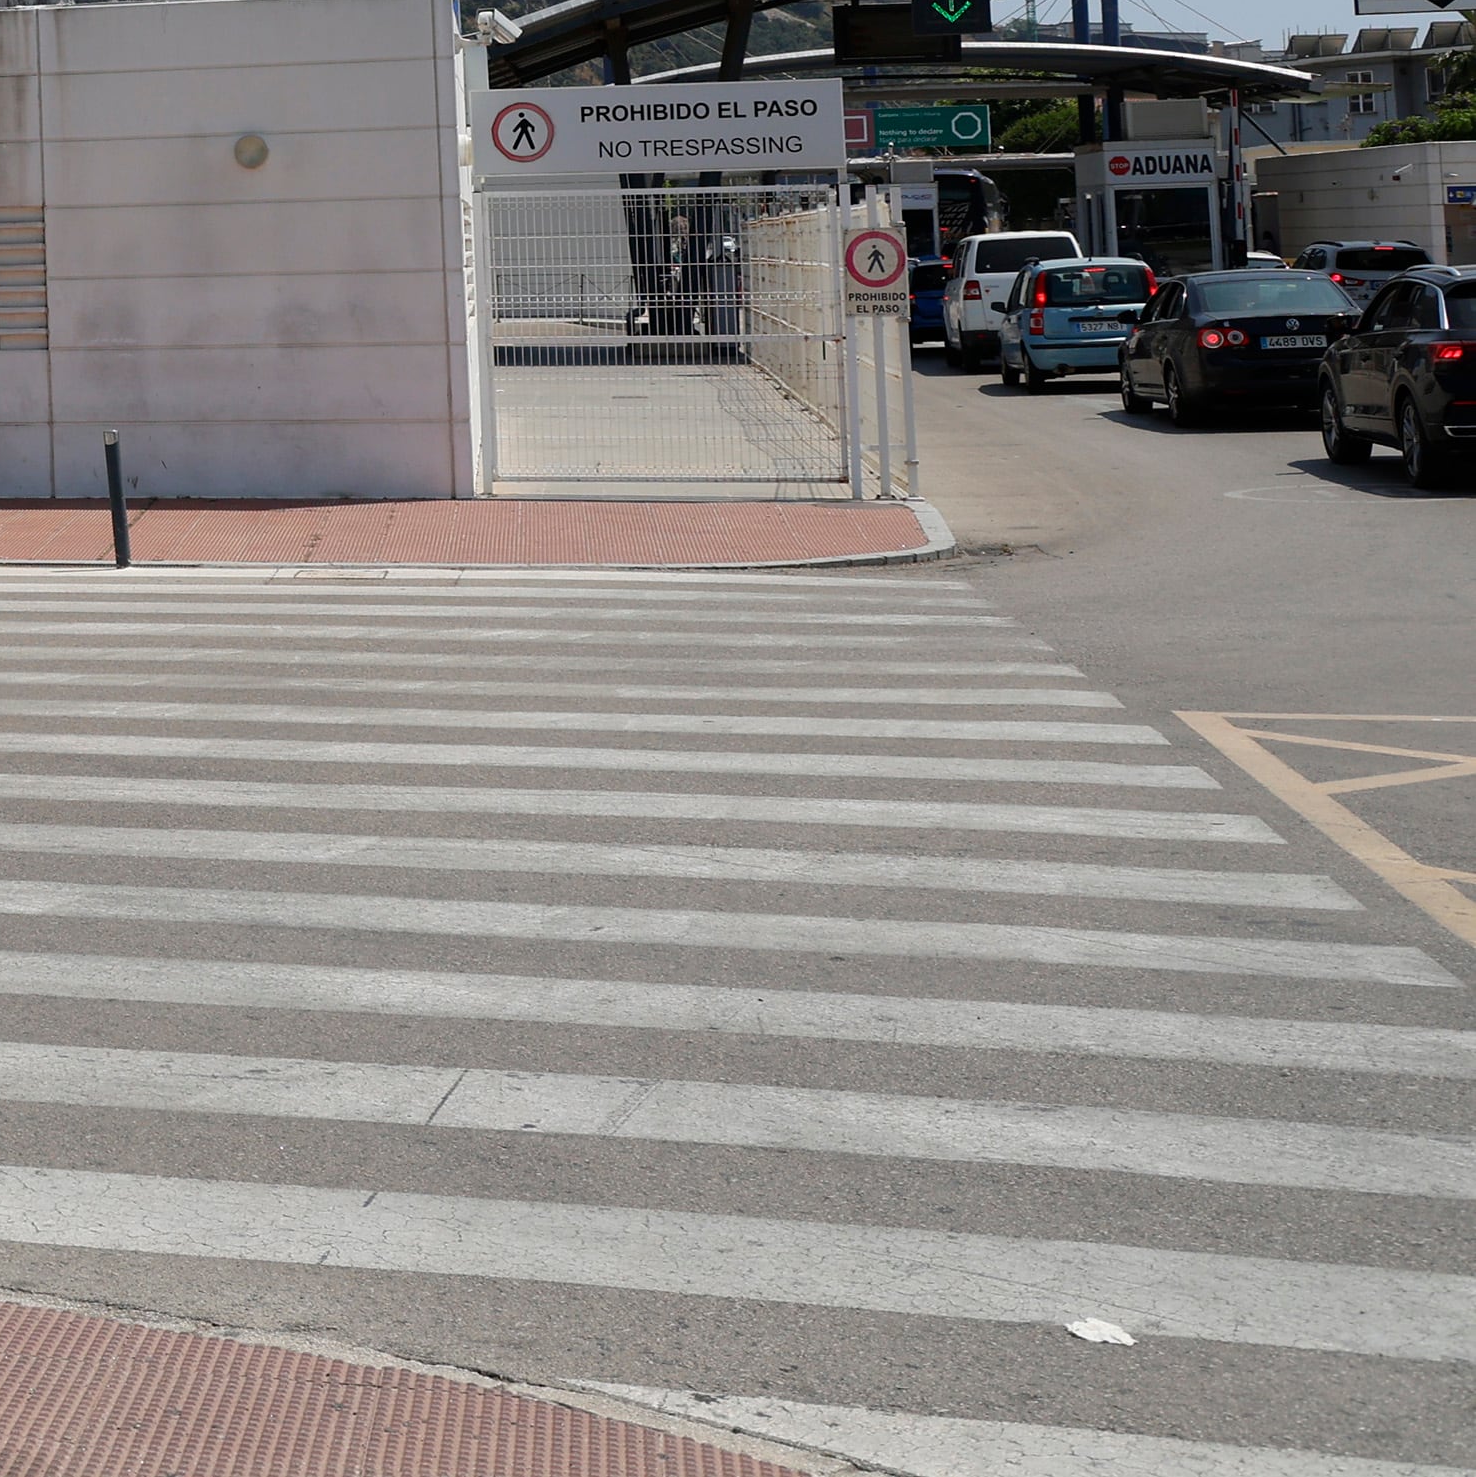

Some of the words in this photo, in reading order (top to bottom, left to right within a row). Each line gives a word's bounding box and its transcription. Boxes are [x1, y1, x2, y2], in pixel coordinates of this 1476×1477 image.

[580, 102, 710, 123] PROHIBIDO
[718, 100, 747, 119] EL
[753, 98, 818, 118] PASO
[879, 129, 908, 138] Nothing
[918, 128, 943, 136] declare
[598, 140, 632, 158] NO
[639, 135, 803, 157] TRESPASSING
[1110, 162, 1129, 170] STOP
[1131, 154, 1213, 175] ADUANA
[848, 292, 907, 302] PROHIBIDO
[856, 304, 869, 314] EL
[872, 304, 900, 313] PASO
